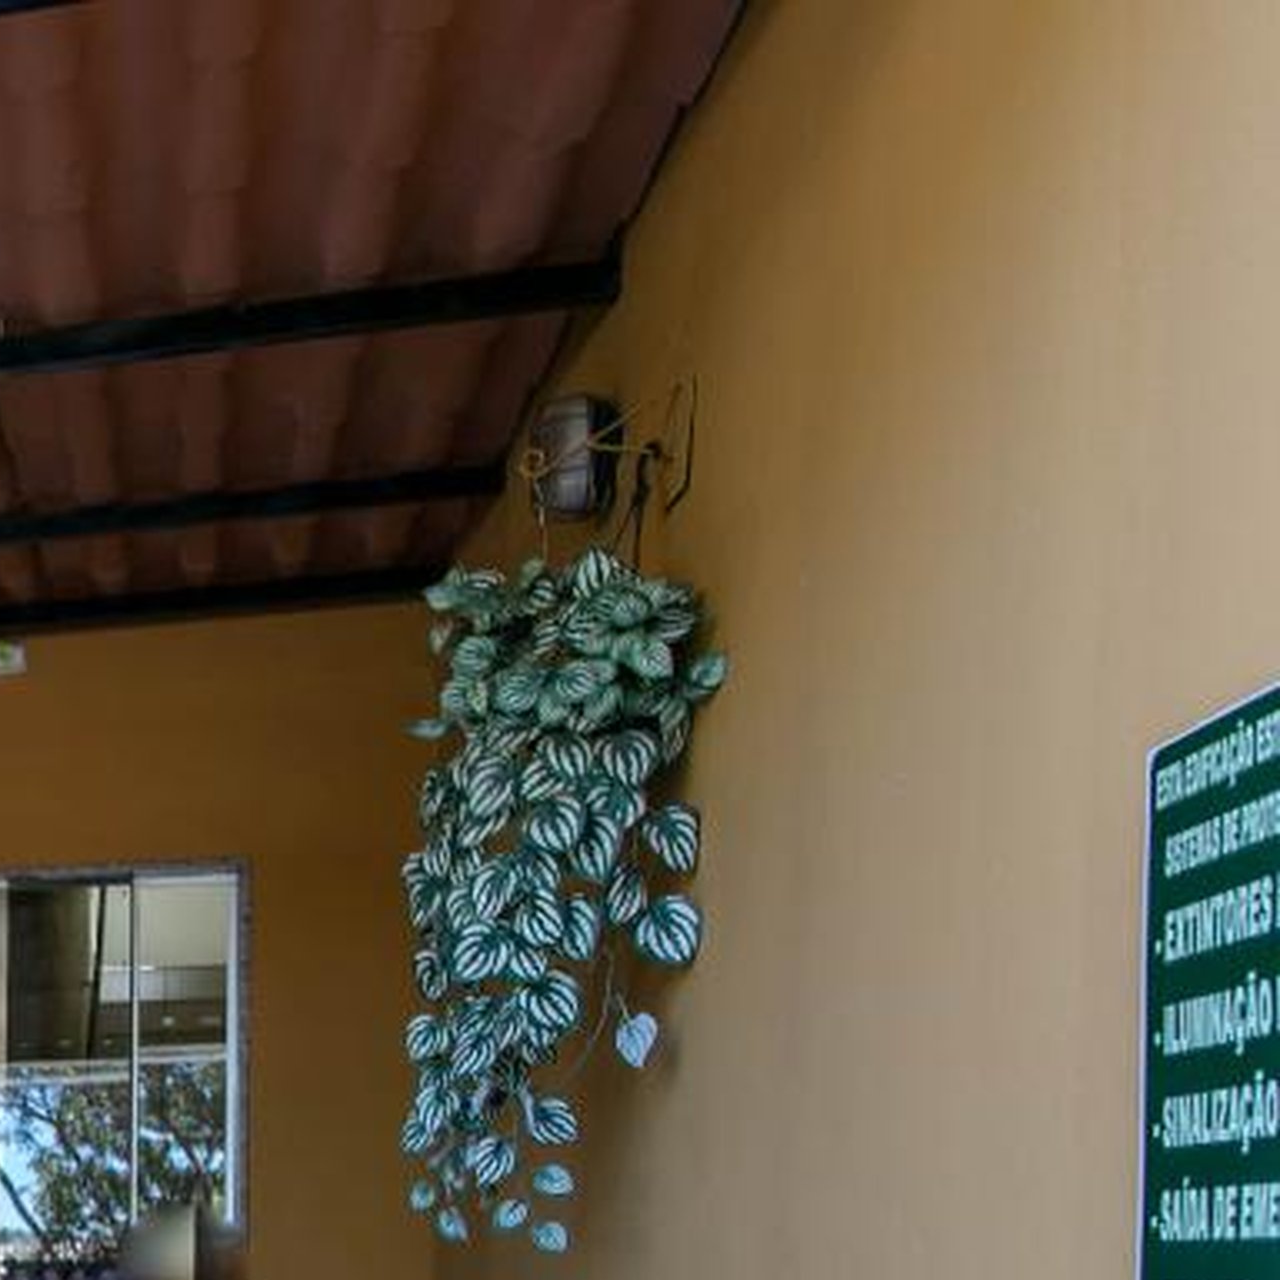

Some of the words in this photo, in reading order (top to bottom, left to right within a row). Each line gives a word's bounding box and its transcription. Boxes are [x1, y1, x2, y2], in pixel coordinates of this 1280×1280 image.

[1164, 815, 1220, 876] SISTEMAS
[1222, 808, 1240, 854] DE
[1165, 875, 1274, 963] EXTINTORES
[1163, 970, 1273, 1056] ILUMINAÇÃO
[1162, 1070, 1278, 1154] SINALIZAÇÃO
[1159, 1176, 1208, 1241] SAÍDA
[1213, 1185, 1239, 1241] DE
